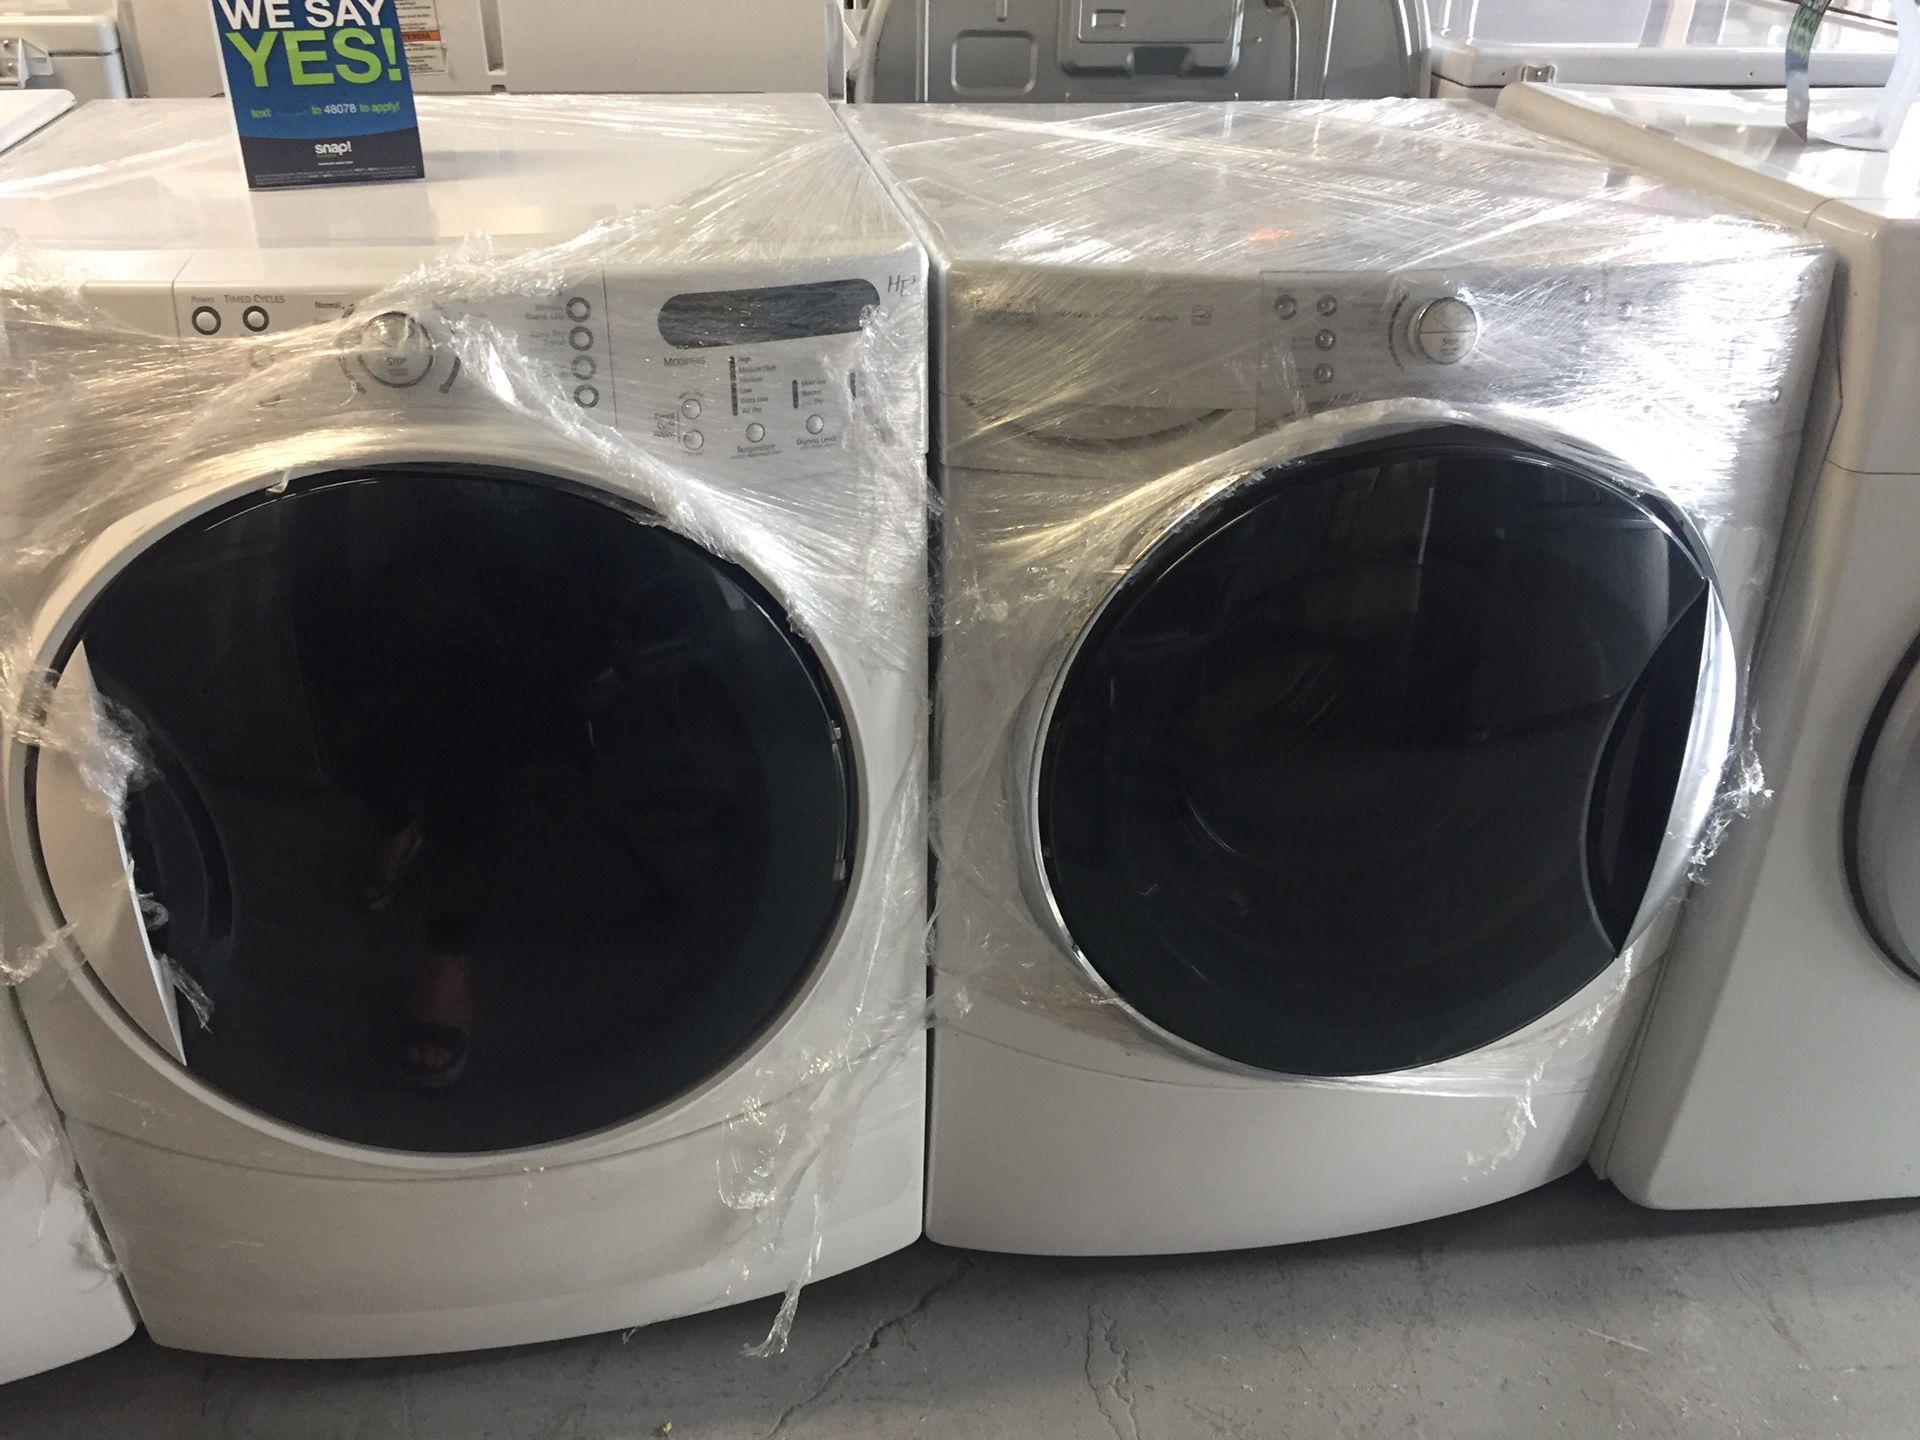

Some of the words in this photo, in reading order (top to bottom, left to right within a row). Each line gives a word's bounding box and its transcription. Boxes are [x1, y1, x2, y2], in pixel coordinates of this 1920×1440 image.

[217, 0, 295, 30] WE
[305, 0, 385, 29] SAY
[225, 28, 403, 88] YES!
[251, 108, 272, 118] text
[311, 106, 322, 115] to
[324, 103, 357, 115] 48078
[359, 103, 370, 113] to
[371, 101, 400, 114] apply!
[315, 141, 352, 155] snap!
[253, 294, 286, 304] CYCLES
